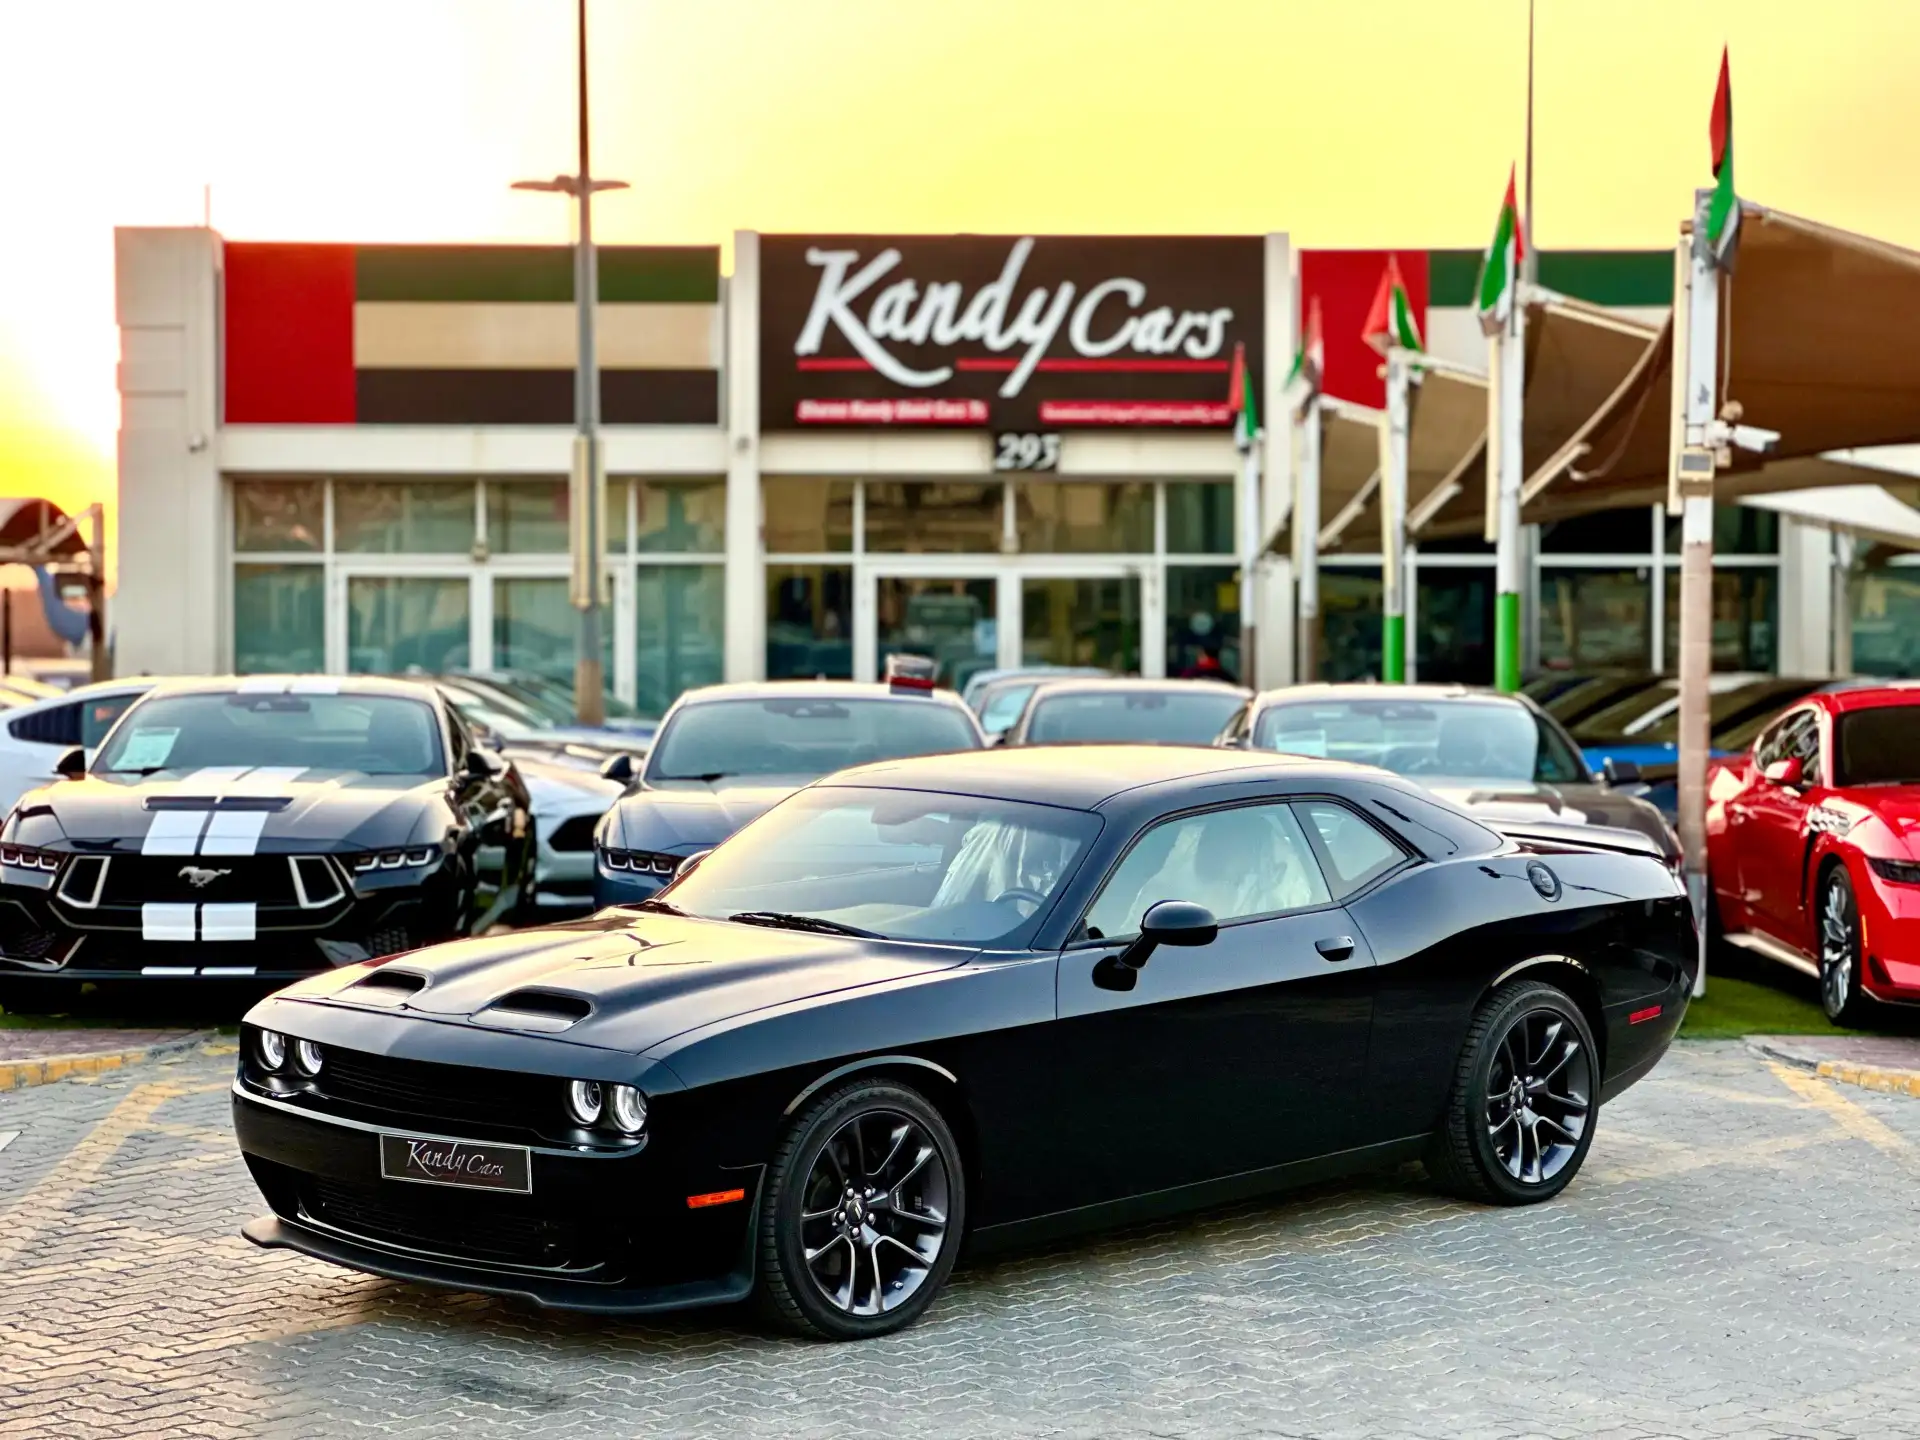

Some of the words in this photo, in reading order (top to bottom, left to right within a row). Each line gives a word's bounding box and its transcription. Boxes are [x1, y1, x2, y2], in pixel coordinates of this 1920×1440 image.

[795, 237, 1075, 398] Kandy
[1070, 278, 1233, 359] Cars
[406, 1140, 465, 1182] Kandy
[466, 1154, 504, 1176] Cars
